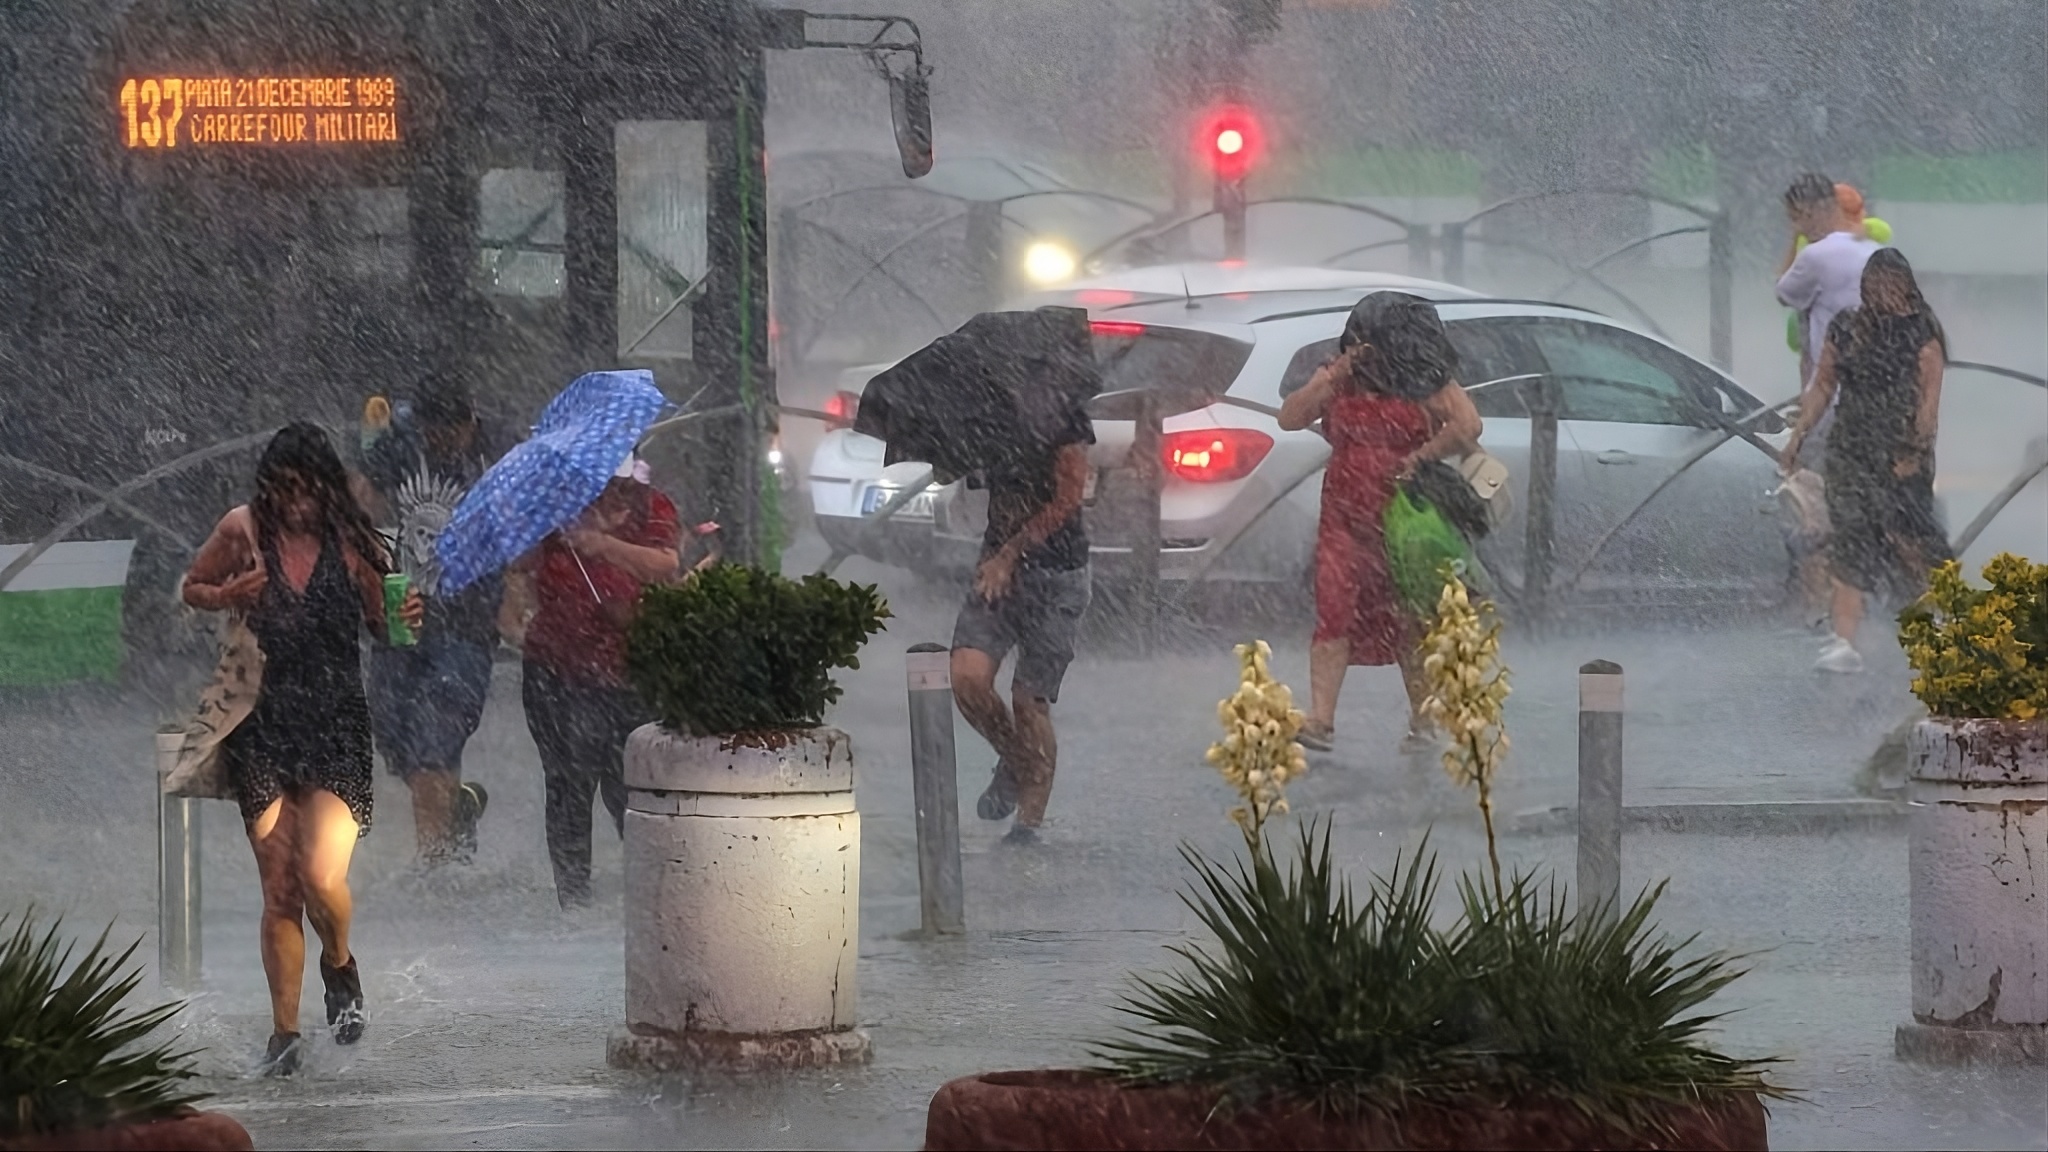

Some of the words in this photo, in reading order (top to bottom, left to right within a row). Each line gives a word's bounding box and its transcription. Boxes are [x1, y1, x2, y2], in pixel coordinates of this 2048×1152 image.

[184, 78, 232, 107] PIATA
[236, 78, 254, 107] 21
[257, 78, 352, 107] DECEMBRIE
[356, 77, 395, 107] 1989
[120, 78, 183, 147] 137
[190, 113, 307, 142] CARREFOUR
[315, 112, 397, 141] MILITARI
